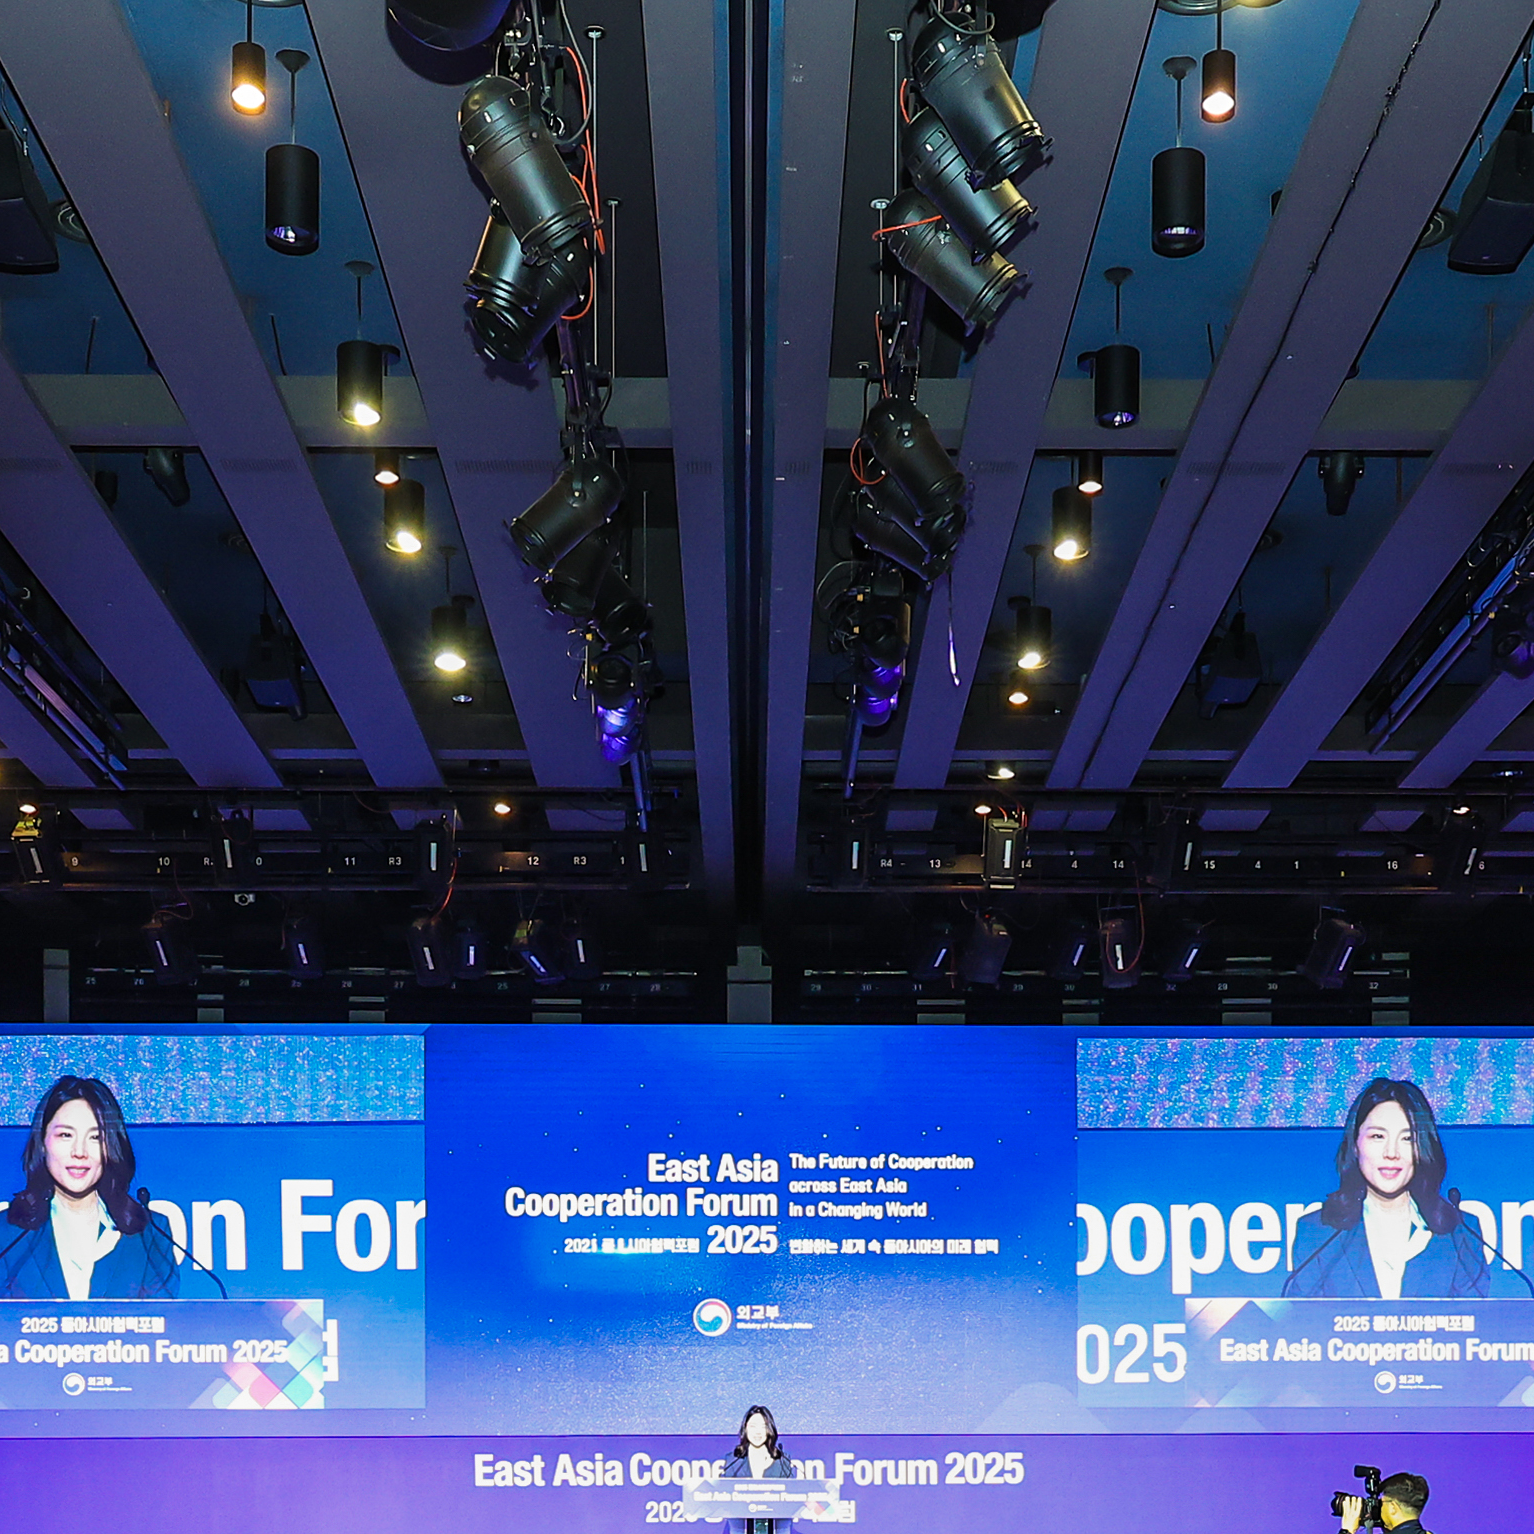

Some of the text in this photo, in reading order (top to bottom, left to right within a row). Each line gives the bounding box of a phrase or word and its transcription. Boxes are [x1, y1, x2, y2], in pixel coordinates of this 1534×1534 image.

[158, 857, 171, 866] 10
[527, 856, 540, 866] 12
[647, 1153, 779, 1182] East Asia
[789, 1153, 975, 1171] The Future of Cooperation
[788, 1177, 908, 1193] across East Asia
[505, 1186, 778, 1222] Cooperation Forum
[788, 1201, 928, 1219] in a Changing World
[707, 1225, 778, 1254] 2025
[736, 1305, 780, 1320] 외교부
[21, 1317, 58, 1334] 2025
[1333, 1315, 1370, 1332] 2025
[14, 1340, 150, 1368] Cooperation
[155, 1340, 227, 1364] Forum
[232, 1340, 290, 1364] 2025
[1219, 1338, 1269, 1363] East
[1273, 1338, 1322, 1362] Asia
[1327, 1338, 1460, 1366] Cooperation
[474, 1453, 545, 1487] East
[553, 1453, 624, 1487] Asia
[835, 1452, 938, 1486] Forum
[944, 1451, 1025, 1485] 2025
